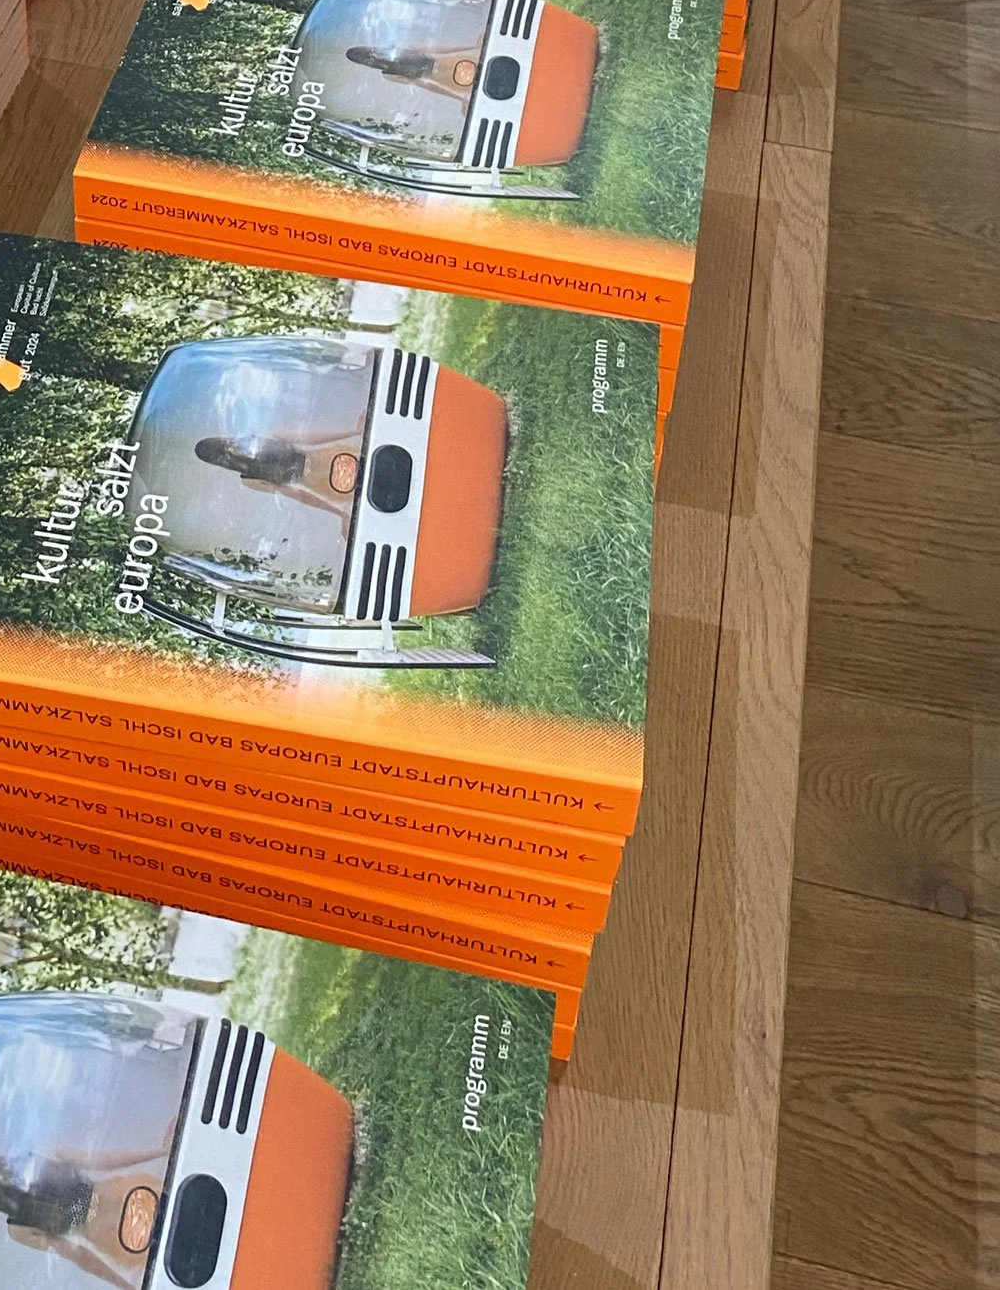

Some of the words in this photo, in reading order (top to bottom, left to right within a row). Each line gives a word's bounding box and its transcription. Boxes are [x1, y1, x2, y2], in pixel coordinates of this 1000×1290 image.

[267, 45, 302, 96] salzt
[209, 72, 258, 136] kultur
[282, 81, 327, 157] europa
[91, 193, 127, 209] 2024
[132, 201, 278, 235] SALZKAMMERGUT
[284, 227, 332, 245] ISCHL
[338, 237, 372, 252] BAD
[378, 244, 456, 267] EUROPAS
[463, 260, 646, 301] KULTURHAUPTSTADT
[25, 332, 41, 356] 2024
[592, 339, 609, 413] programm
[96, 441, 141, 517] salzt
[21, 483, 85, 584] kultur
[115, 494, 171, 614] europa
[119, 718, 181, 739] ISCHL
[189, 731, 232, 748] BAD
[240, 740, 341, 767] EUROPAS
[116, 759, 176, 781] ISCHL
[184, 774, 226, 791] BAD
[350, 759, 583, 809] KULTURHAUPTSTADT
[234, 783, 332, 812] EUROPAS
[114, 807, 173, 828] ISCHL
[180, 821, 221, 839] BAD
[339, 805, 567, 859] KULTURHAUPTSTADT
[107, 848, 164, 871] ISCHL
[229, 831, 325, 860] EUROPAS
[171, 865, 211, 883] BAD
[332, 853, 556, 908] KULTURHAUPTSTADT
[218, 876, 312, 908] EUROPAS
[320, 903, 537, 964] KULTURHAUPTSTADT
[501, 1019, 512, 1035] EN
[498, 1044, 509, 1059] DE
[462, 1014, 490, 1131] programm
